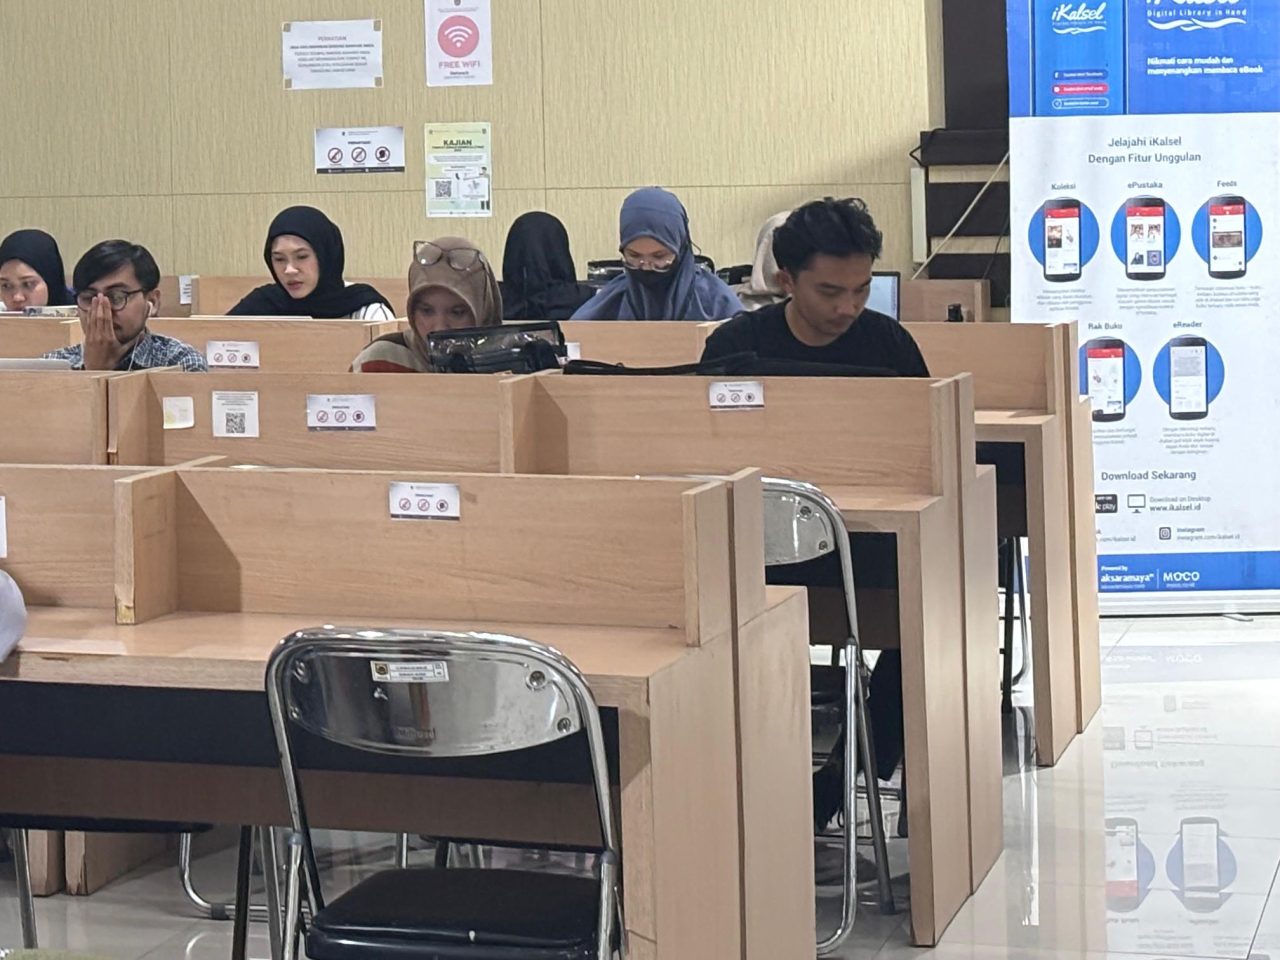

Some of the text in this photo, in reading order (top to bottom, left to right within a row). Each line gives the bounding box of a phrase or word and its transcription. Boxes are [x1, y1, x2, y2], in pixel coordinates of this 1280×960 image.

[1051, 2, 1107, 21] iKalsel
[1146, 9, 1176, 18] Digital
[1179, 9, 1211, 17] Library
[1225, 8, 1247, 16] Hand
[438, 61, 460, 69] FREE
[1108, 135, 1182, 149] Jelajahi iKalsel
[1088, 152, 1202, 165] Dengan Fitur Unggulan
[1051, 183, 1077, 191] Koleksi
[1127, 181, 1163, 190] ePustaka
[1217, 179, 1238, 188] Feeds
[1101, 470, 1197, 481] Download Sekarang
[1163, 571, 1200, 581] MOCO
